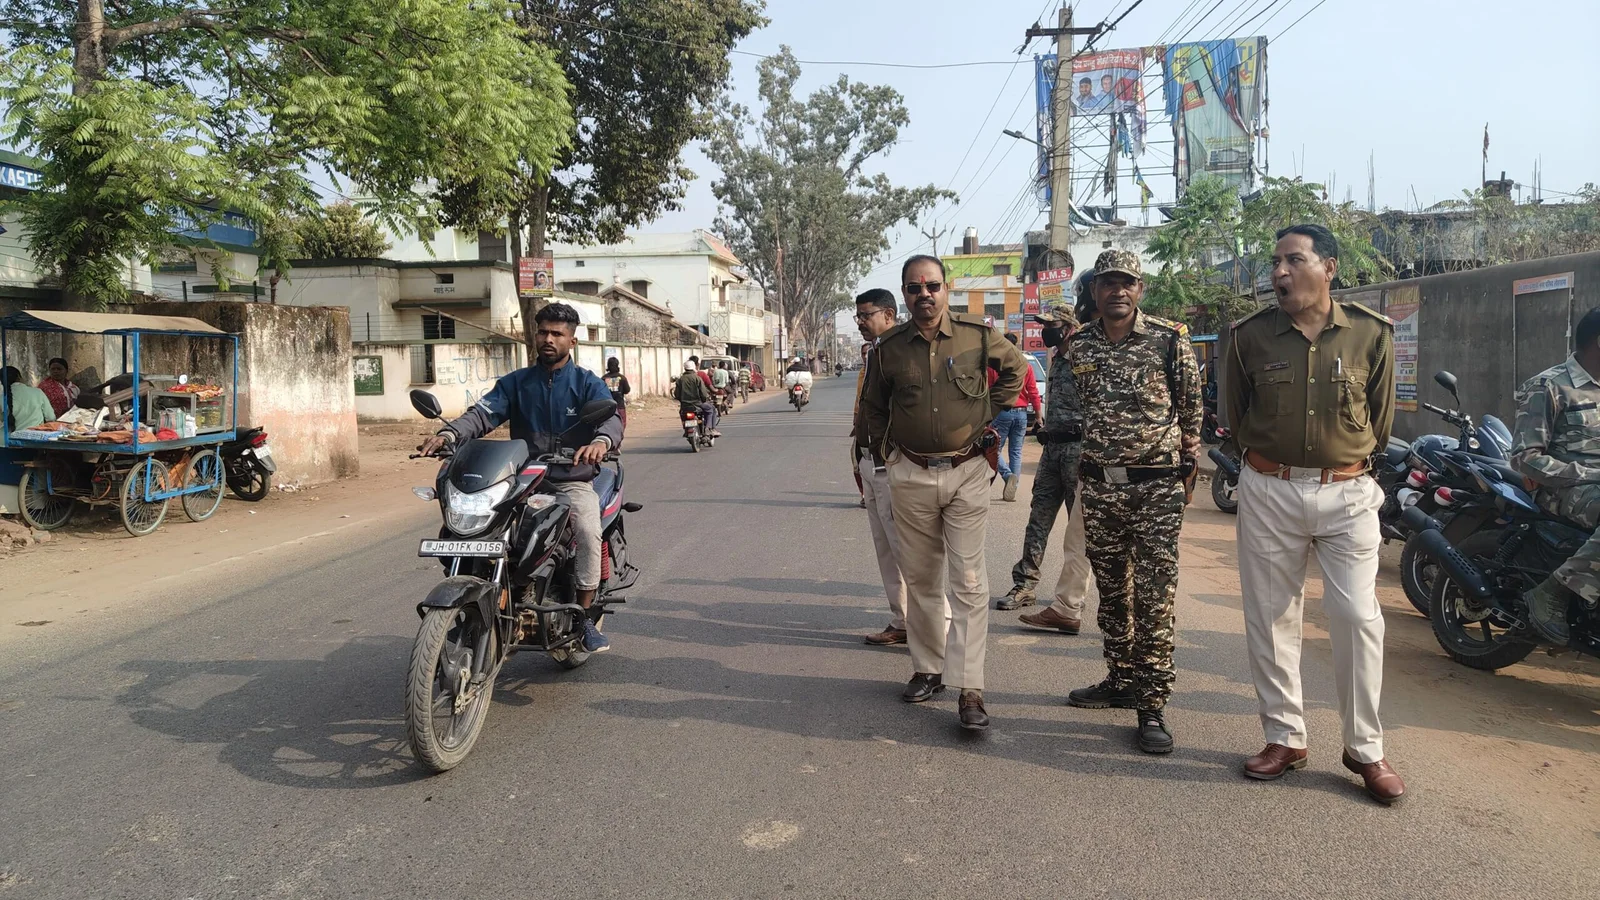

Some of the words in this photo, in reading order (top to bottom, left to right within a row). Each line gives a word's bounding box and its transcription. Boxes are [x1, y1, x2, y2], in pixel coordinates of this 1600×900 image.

[1040, 269, 1071, 281] J.M.S.
[432, 543, 446, 551] JH
[448, 543, 472, 551] 01FK
[476, 543, 501, 552] 0156
